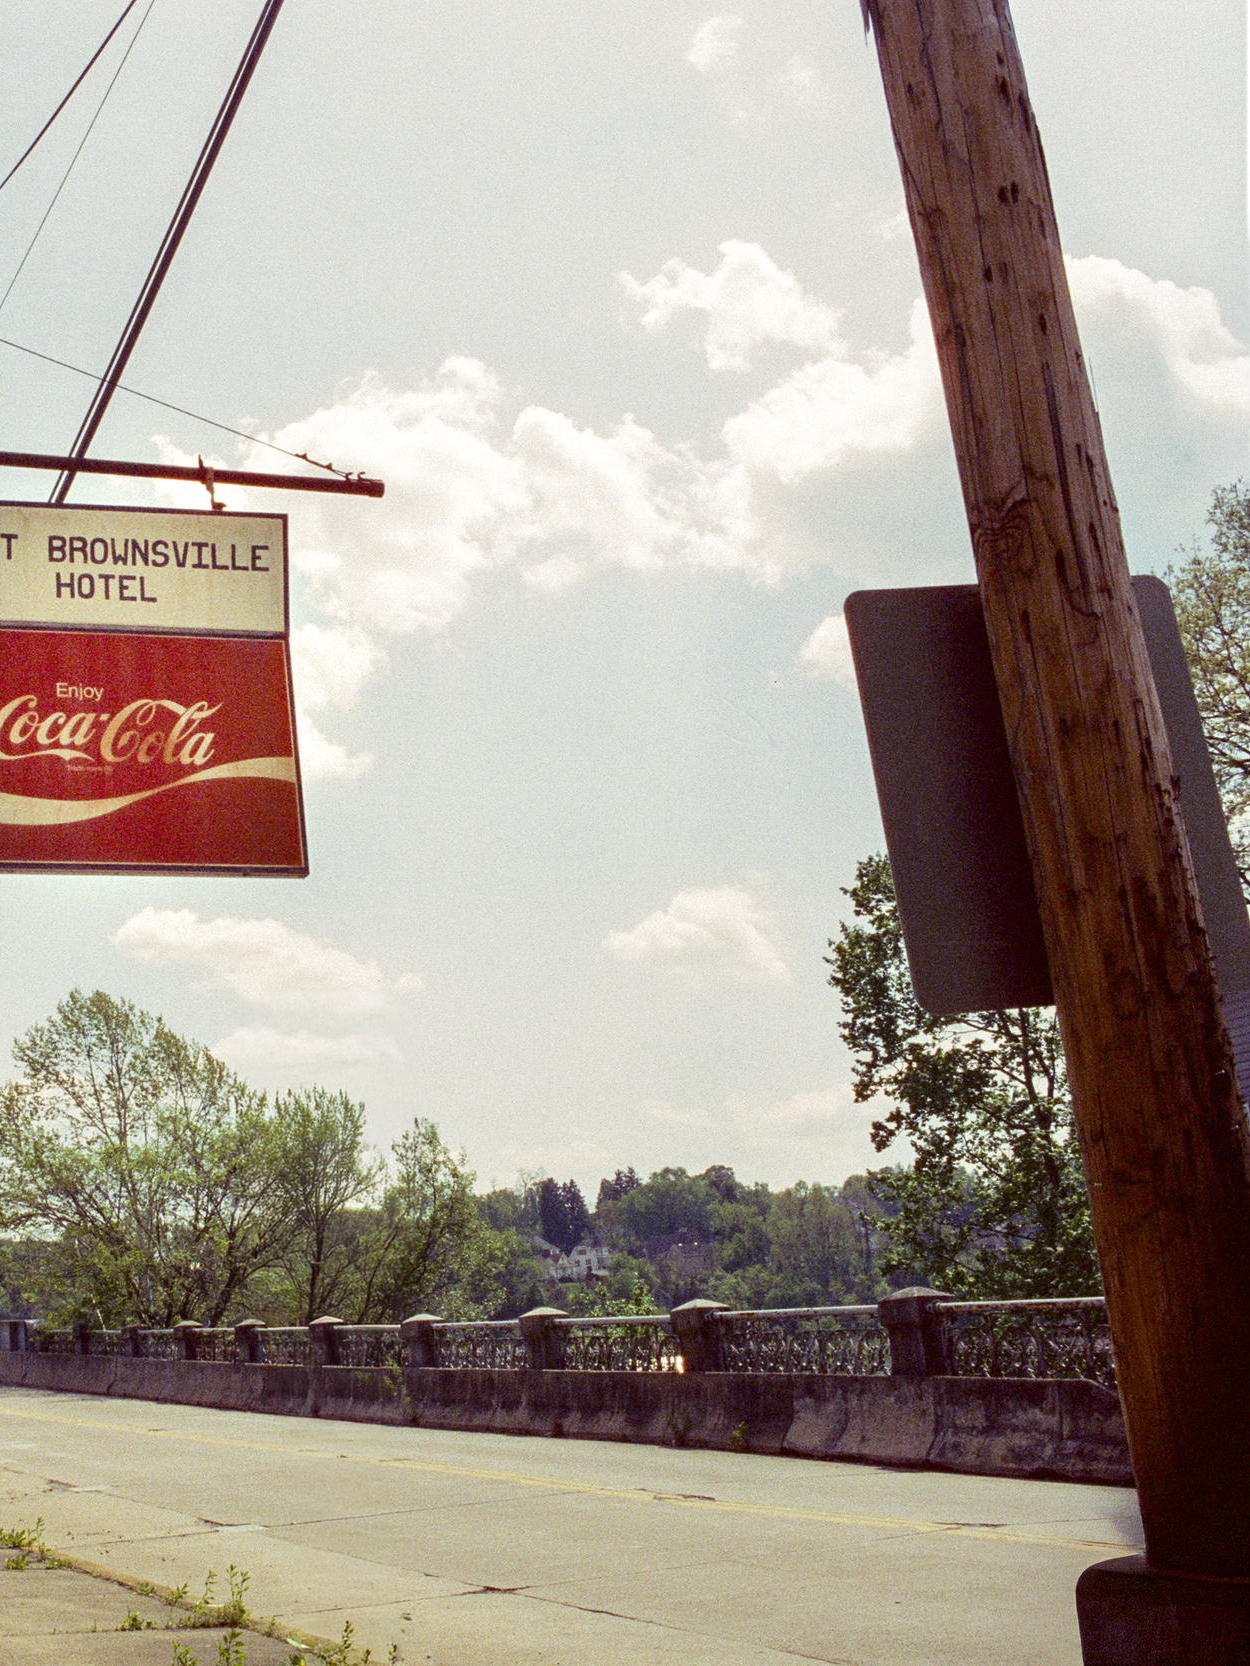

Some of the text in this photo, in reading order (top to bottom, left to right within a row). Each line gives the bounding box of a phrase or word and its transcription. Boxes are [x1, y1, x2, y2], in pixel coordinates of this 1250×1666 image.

[48, 535, 270, 572] BROWNSVILLE
[55, 572, 158, 603] HOTEL
[56, 682, 104, 701] Enjoy
